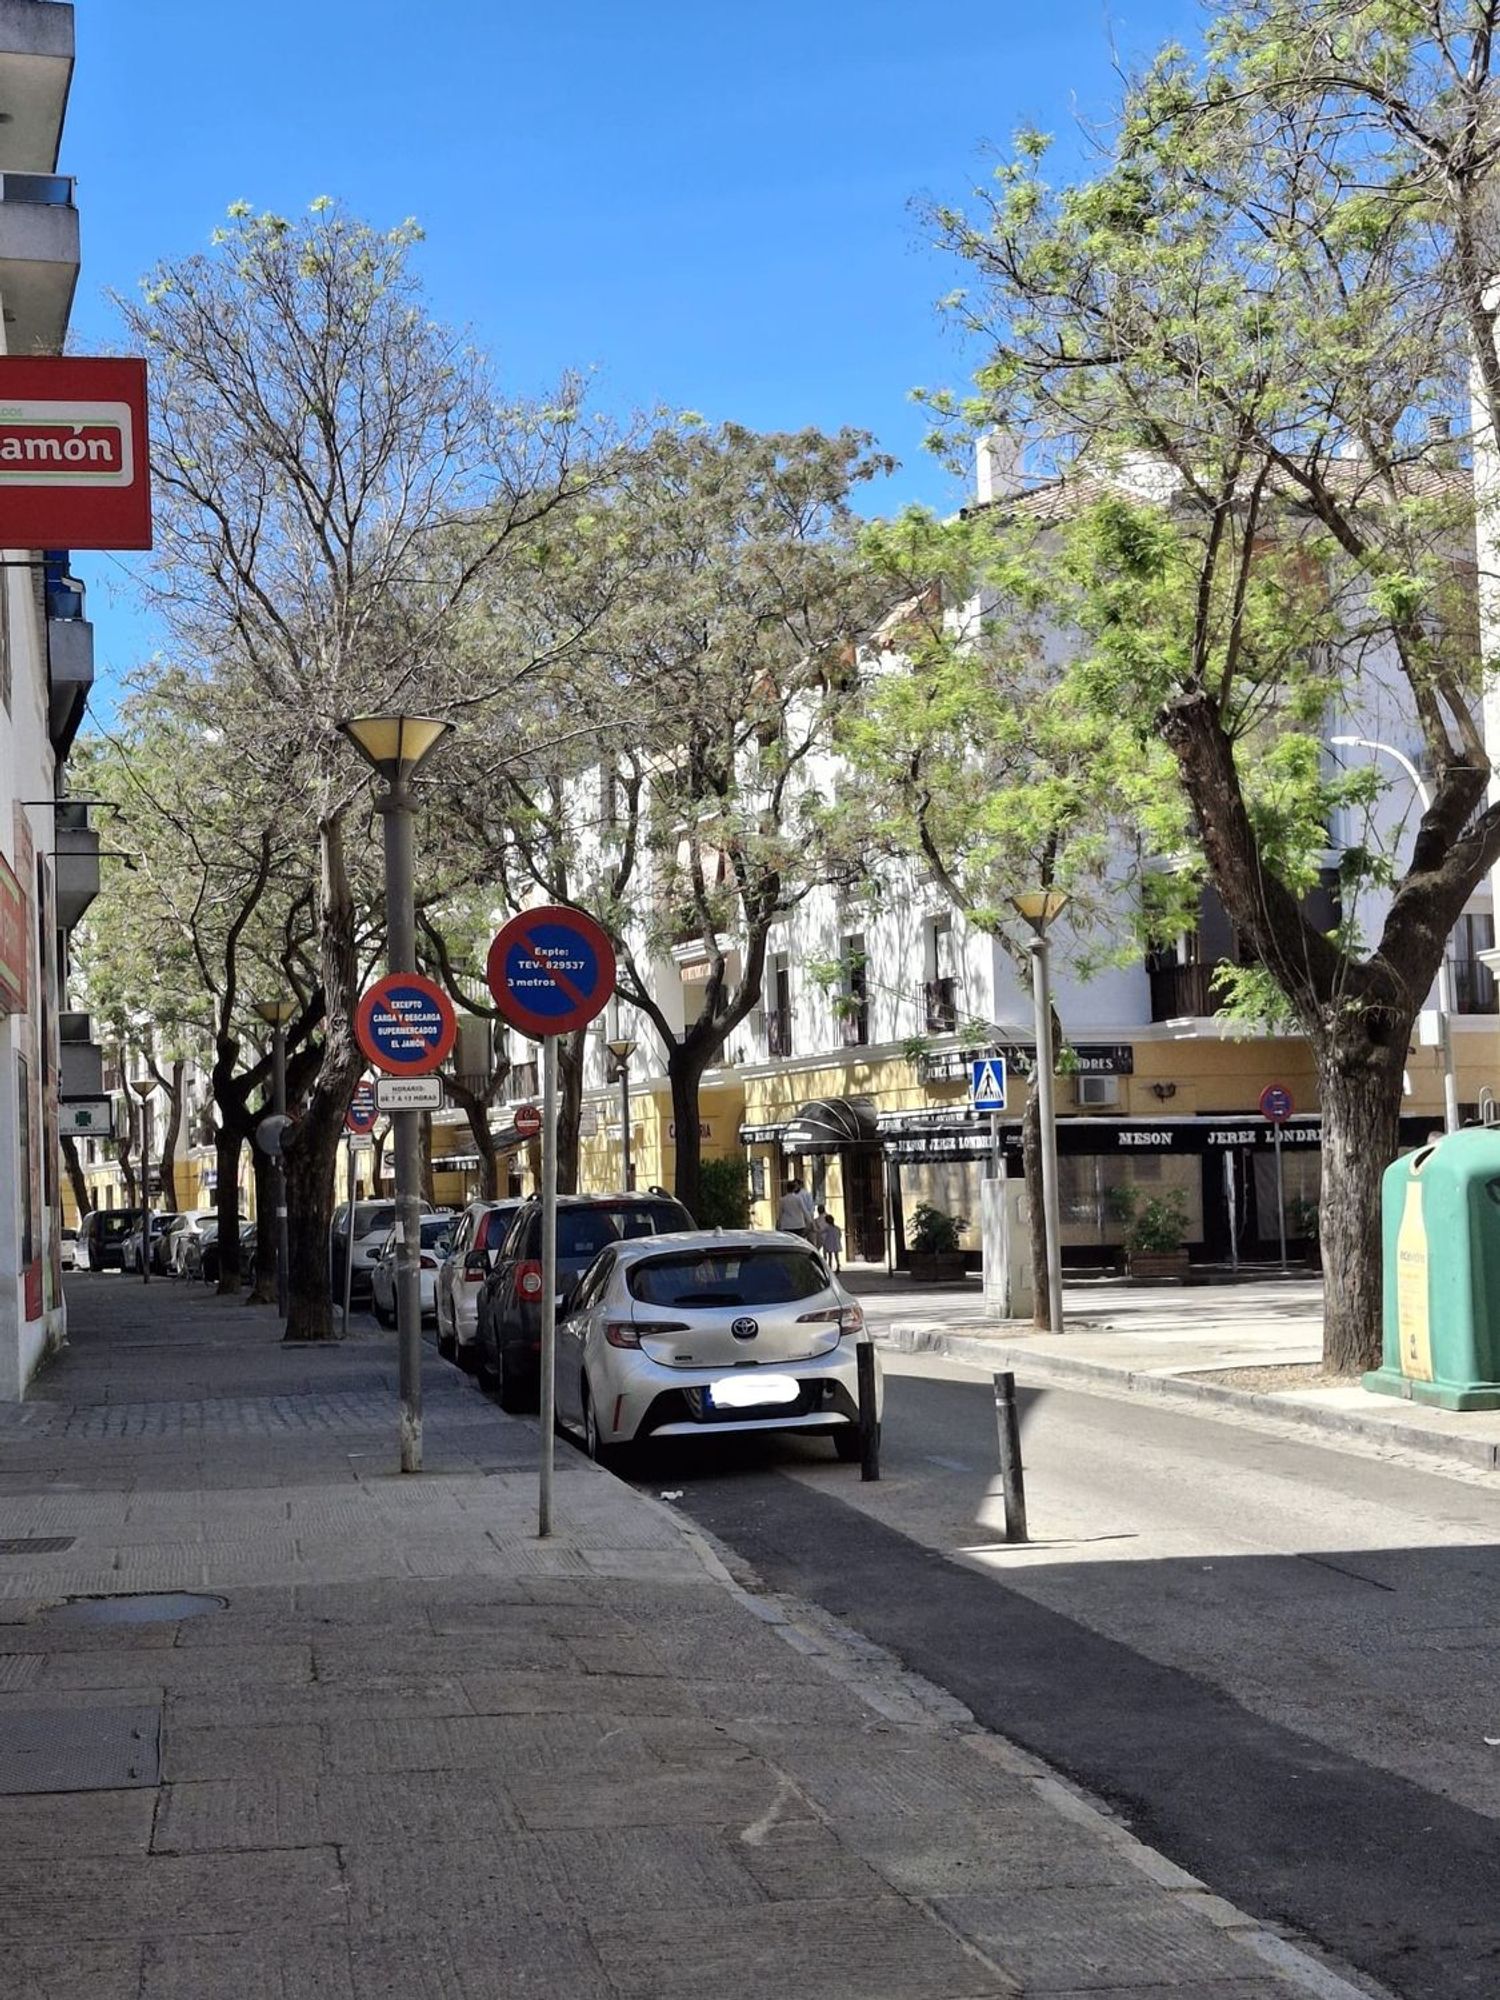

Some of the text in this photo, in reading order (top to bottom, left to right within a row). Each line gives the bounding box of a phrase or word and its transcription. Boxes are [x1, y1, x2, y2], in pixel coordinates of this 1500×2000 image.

[546, 960, 586, 970] 829537
[507, 978, 556, 987] 3 metros
[391, 1000, 423, 1010] EXCEPTO
[373, 1013, 397, 1023] CARGA
[404, 1012, 441, 1022] DESCARGA
[377, 1025, 438, 1036] SUPERMERCADOS
[390, 1039, 400, 1048] EL
[1118, 1131, 1173, 1145] MESON
[1207, 1131, 1256, 1144] JEREZ
